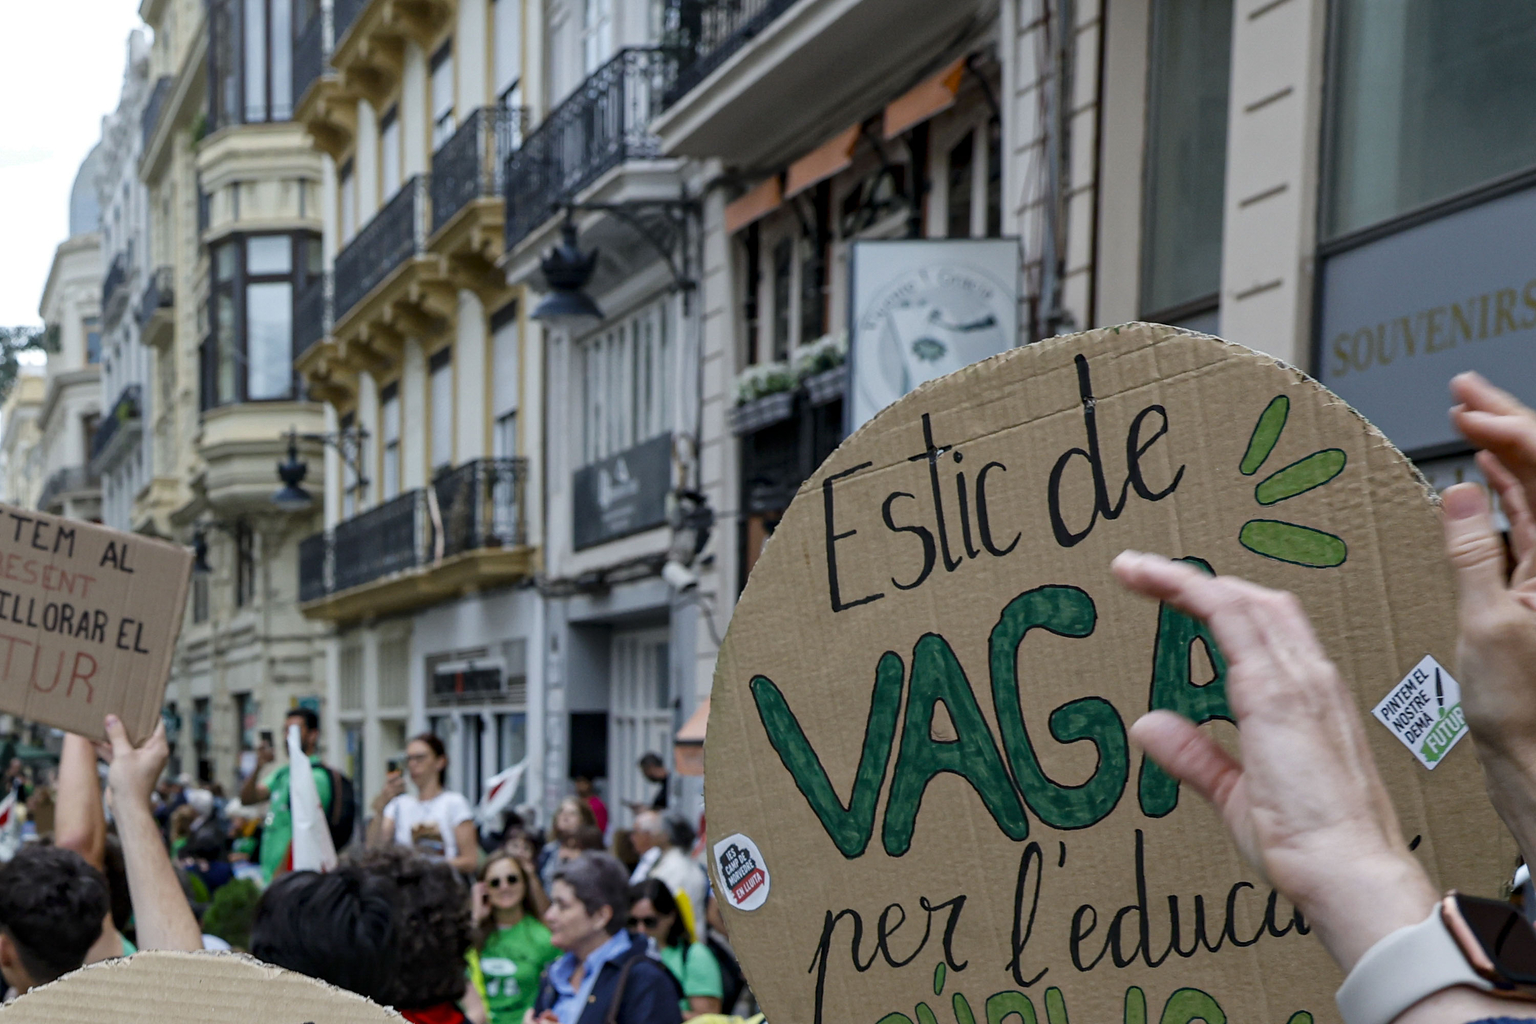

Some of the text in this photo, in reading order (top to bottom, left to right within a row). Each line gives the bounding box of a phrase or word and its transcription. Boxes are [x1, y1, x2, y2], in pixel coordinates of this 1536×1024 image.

[1331, 278, 1536, 378] SOUVENIRS
[822, 353, 1186, 613] Estic de
[99, 540, 135, 575] AL
[115, 617, 150, 655] EL
[749, 556, 1242, 859] VAGA
